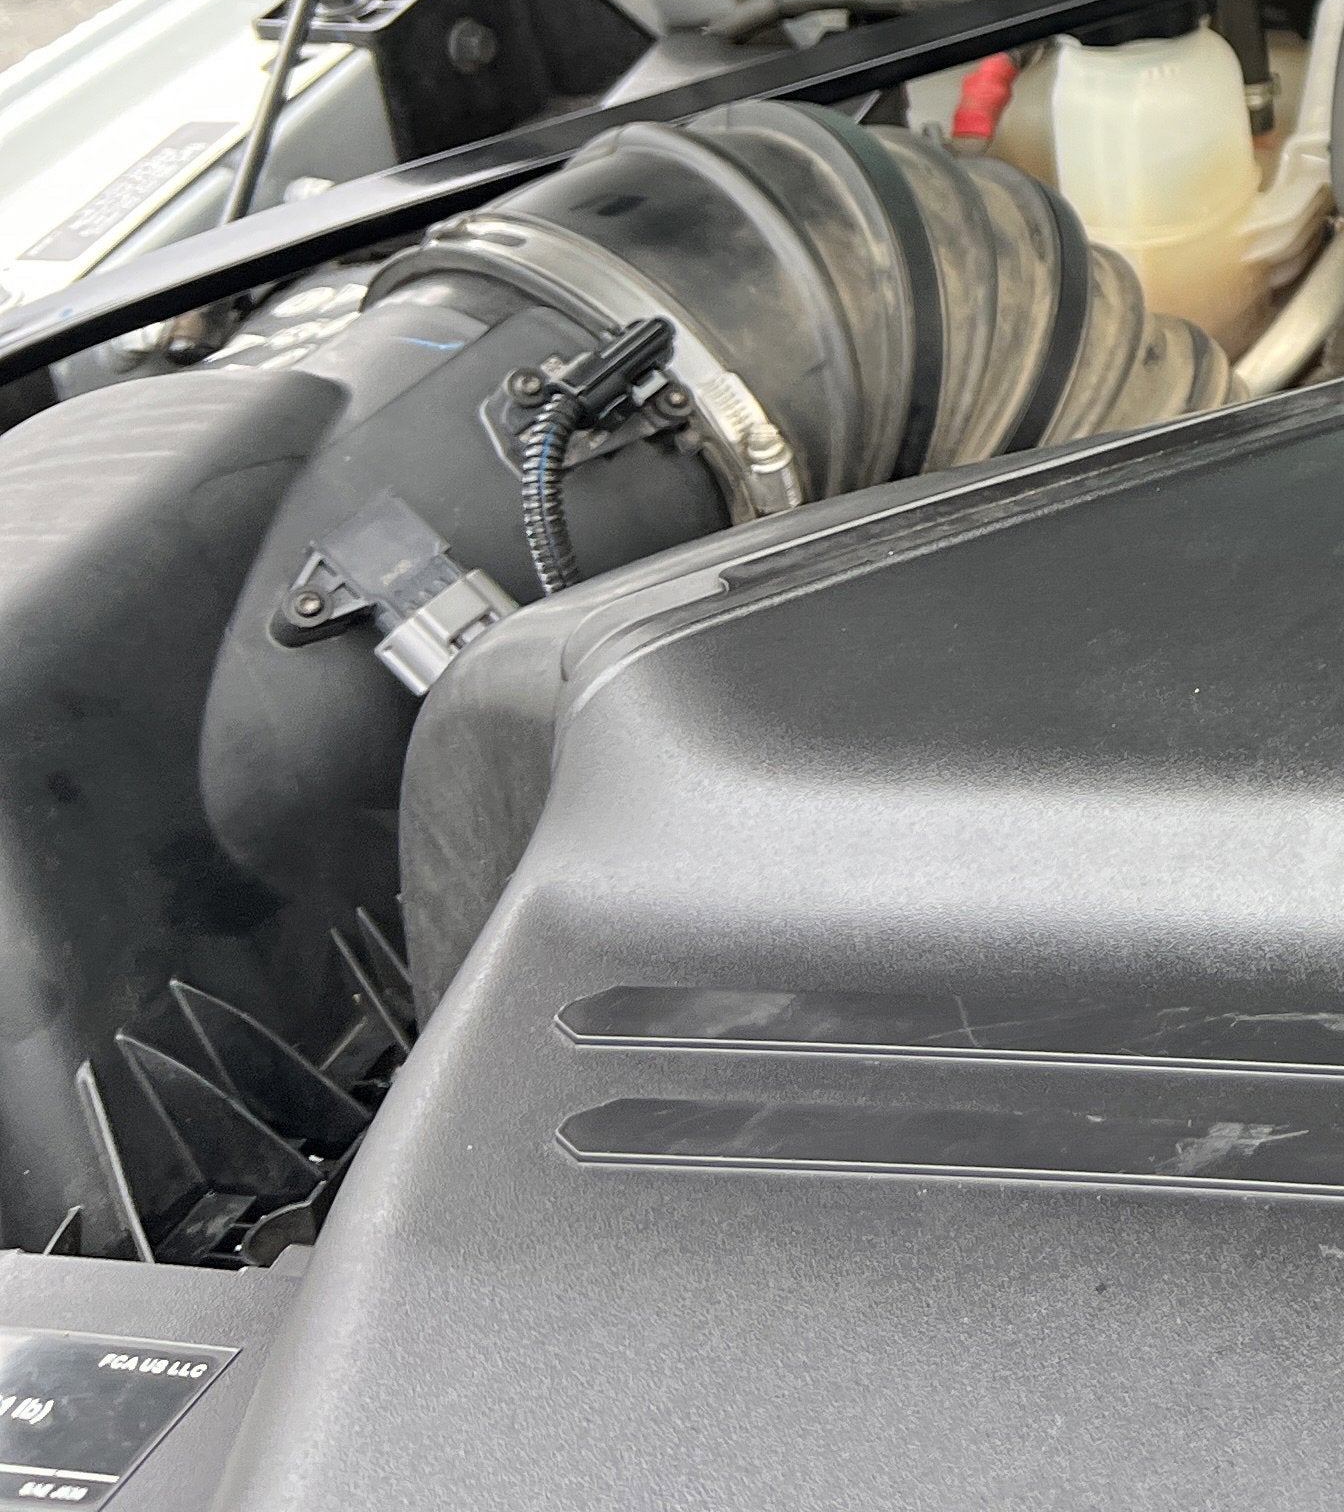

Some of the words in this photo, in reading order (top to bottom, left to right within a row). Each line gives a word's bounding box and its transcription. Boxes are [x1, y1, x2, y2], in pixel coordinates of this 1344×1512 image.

[98, 1353, 139, 1371] FCA
[166, 1361, 208, 1378] LLC
[11, 1397, 54, 1425] lb)
